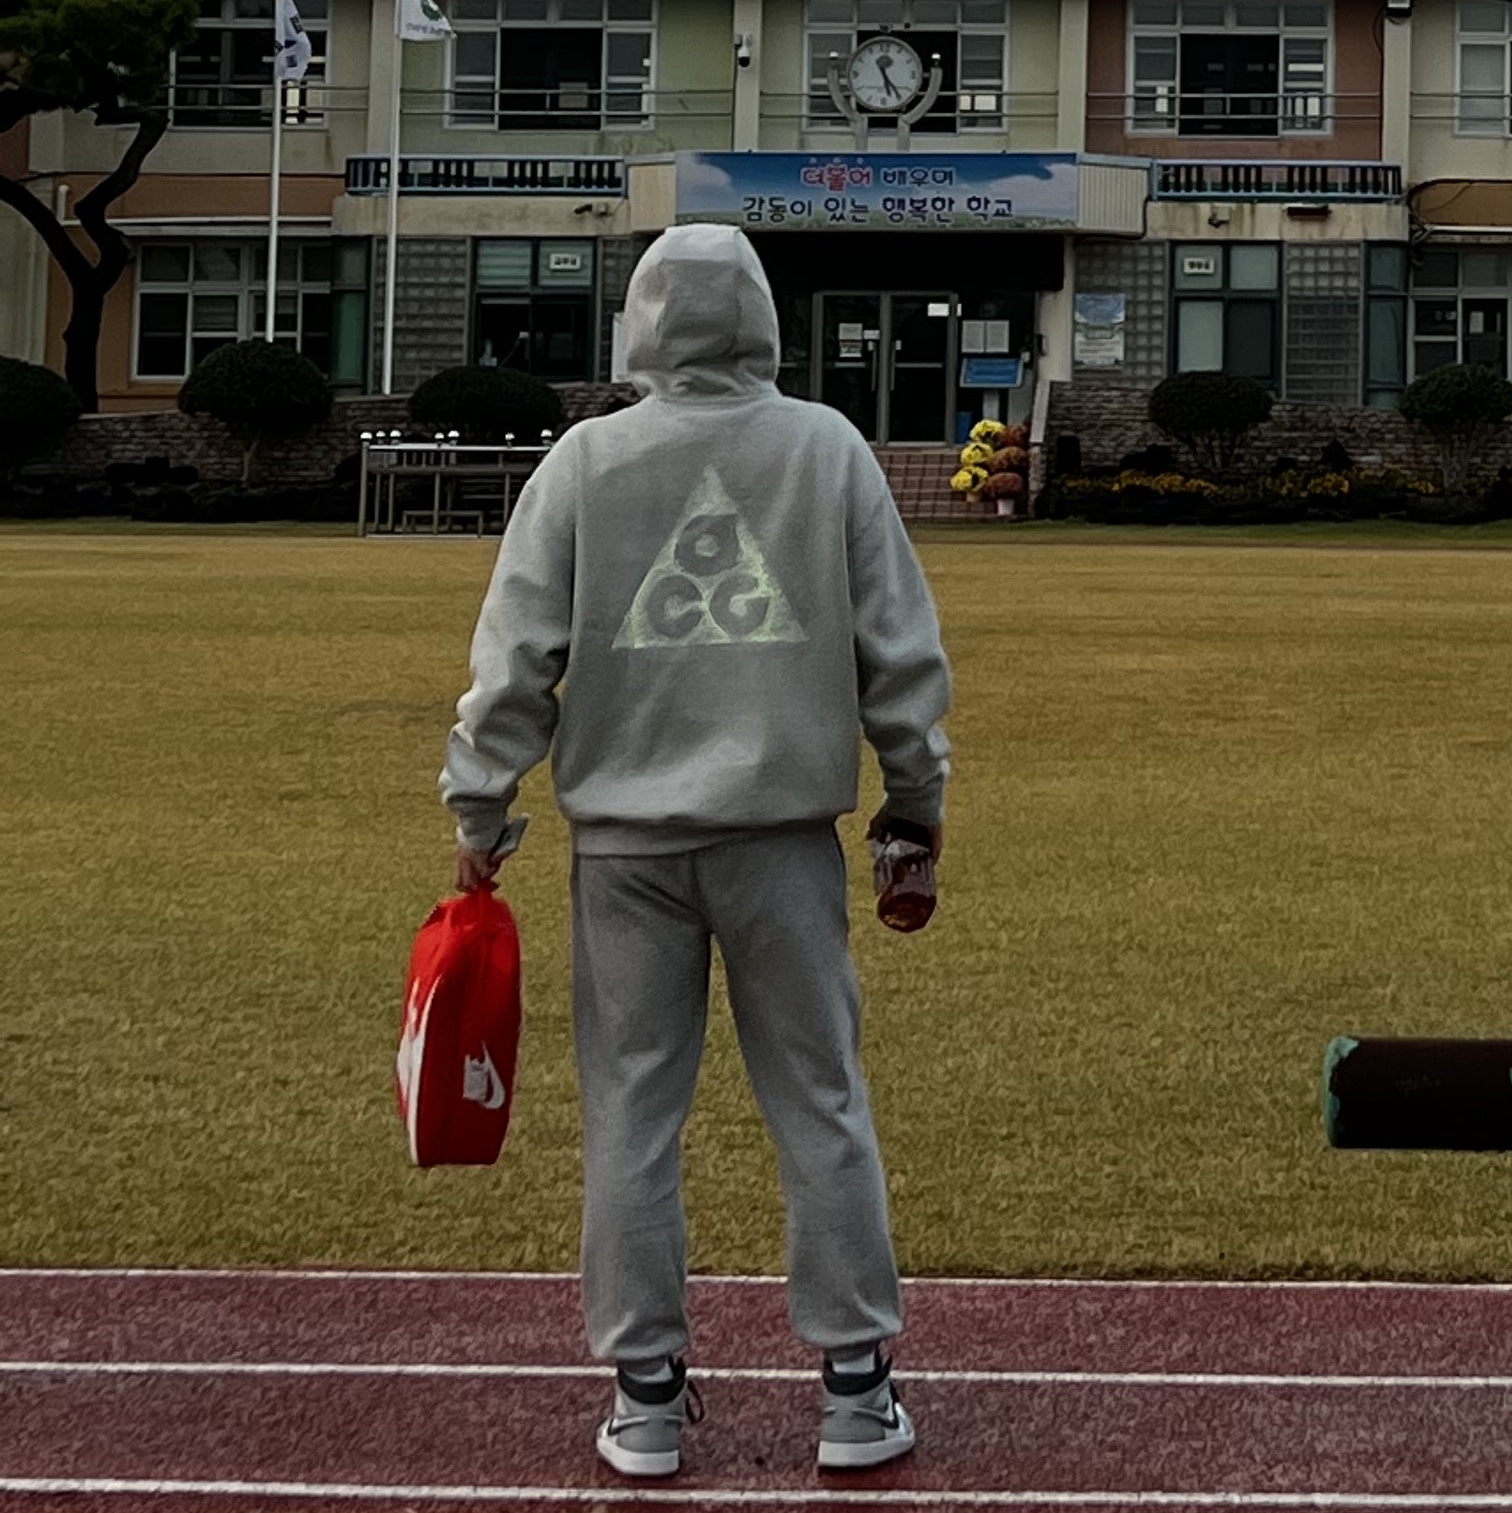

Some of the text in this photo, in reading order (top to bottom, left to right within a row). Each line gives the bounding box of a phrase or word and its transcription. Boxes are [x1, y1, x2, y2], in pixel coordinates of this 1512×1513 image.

[802, 164, 871, 192] 더불어
[742, 195, 1013, 223] 감동이 있는 행복한 학교
